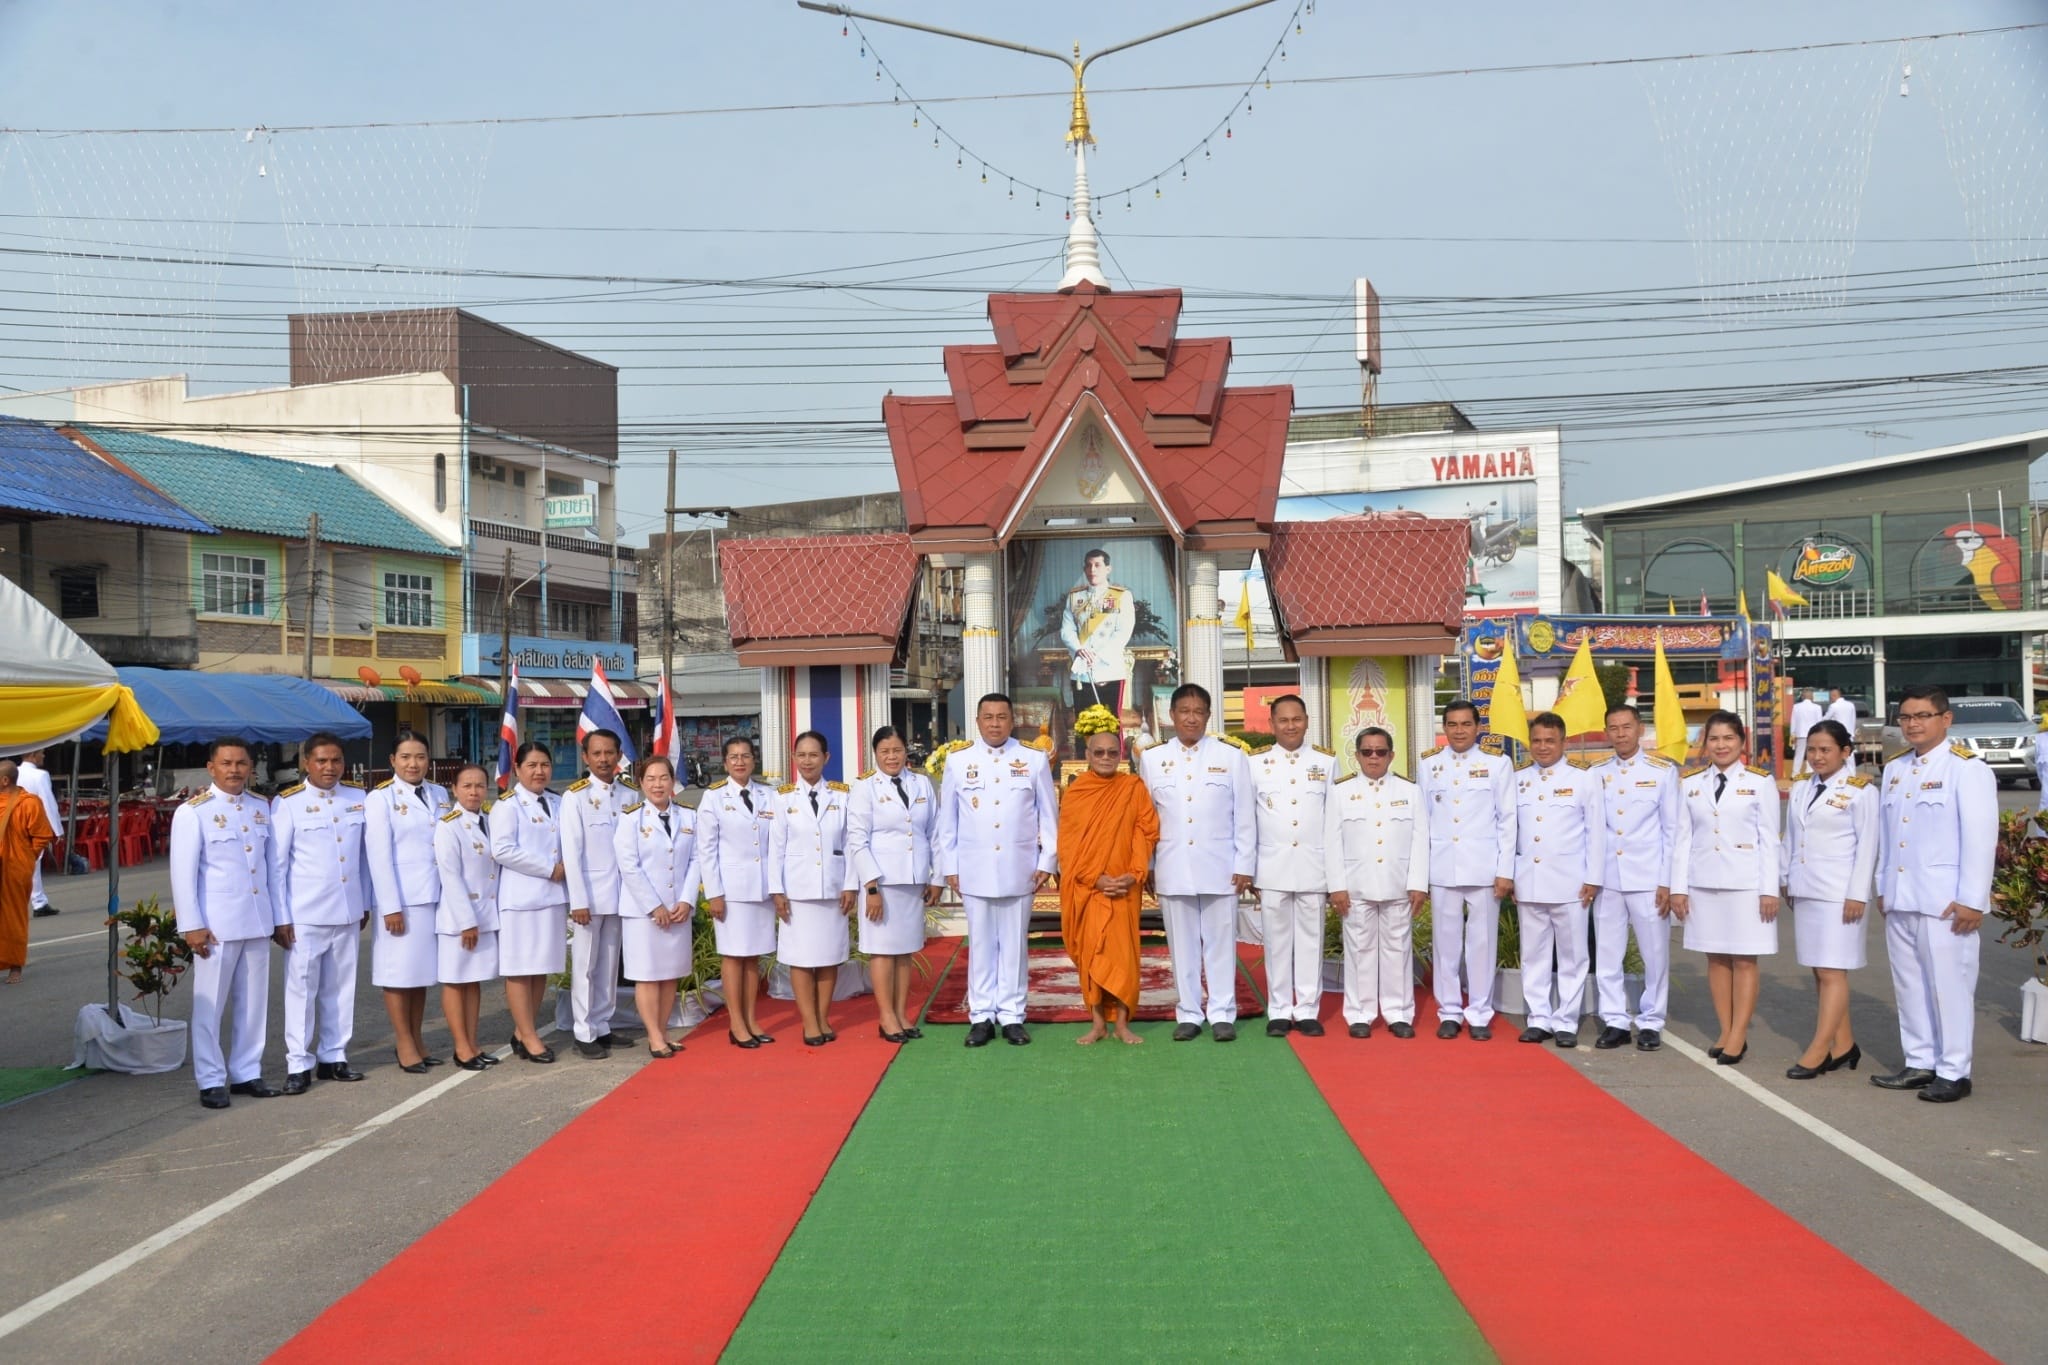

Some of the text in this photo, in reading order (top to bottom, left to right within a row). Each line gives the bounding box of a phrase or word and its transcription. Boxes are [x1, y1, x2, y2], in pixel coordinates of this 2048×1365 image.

[1431, 447, 1534, 481] YAMAHA
[544, 497, 590, 515] ขายยา
[1796, 642, 1874, 657] Amazon
